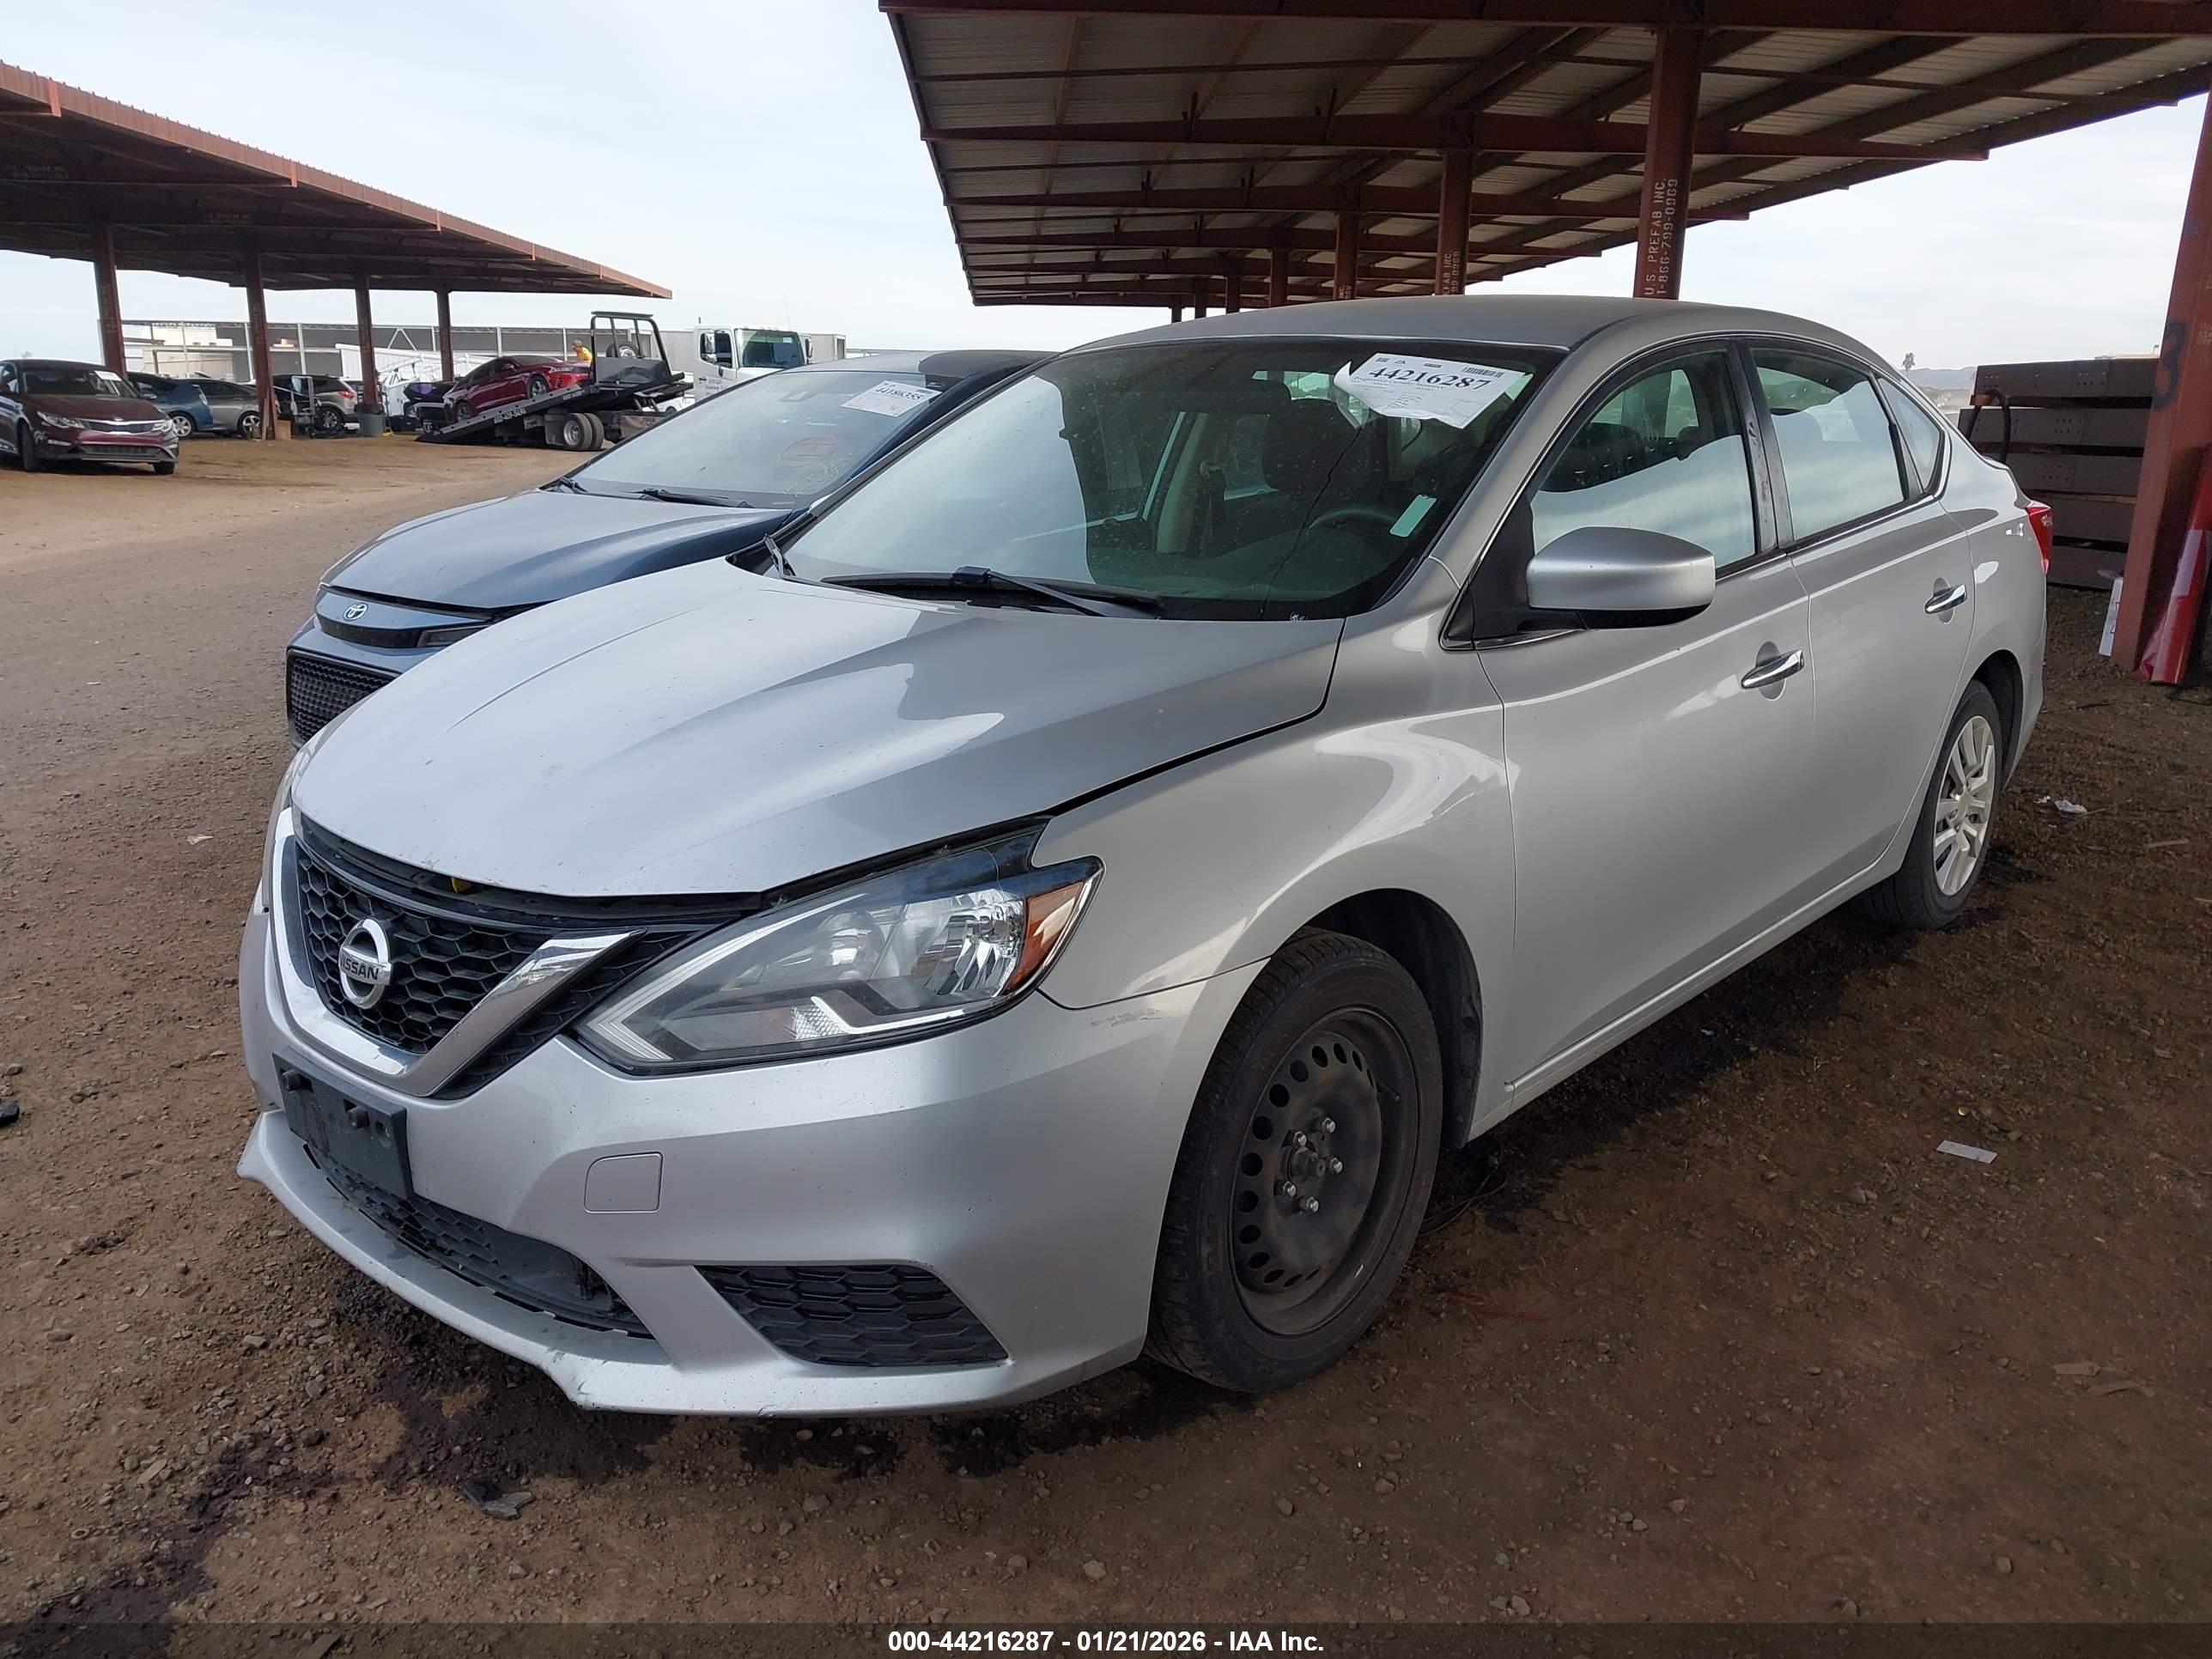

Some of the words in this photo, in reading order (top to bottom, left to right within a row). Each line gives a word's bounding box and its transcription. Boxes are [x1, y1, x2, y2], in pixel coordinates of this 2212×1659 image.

[1652, 178, 1666, 204] INC.
[1647, 210, 1662, 262] PREFAB
[1656, 179, 1678, 295] 1-866-799-0969
[1369, 367, 1492, 391] 44216287
[341, 953, 379, 981] NISSAN
